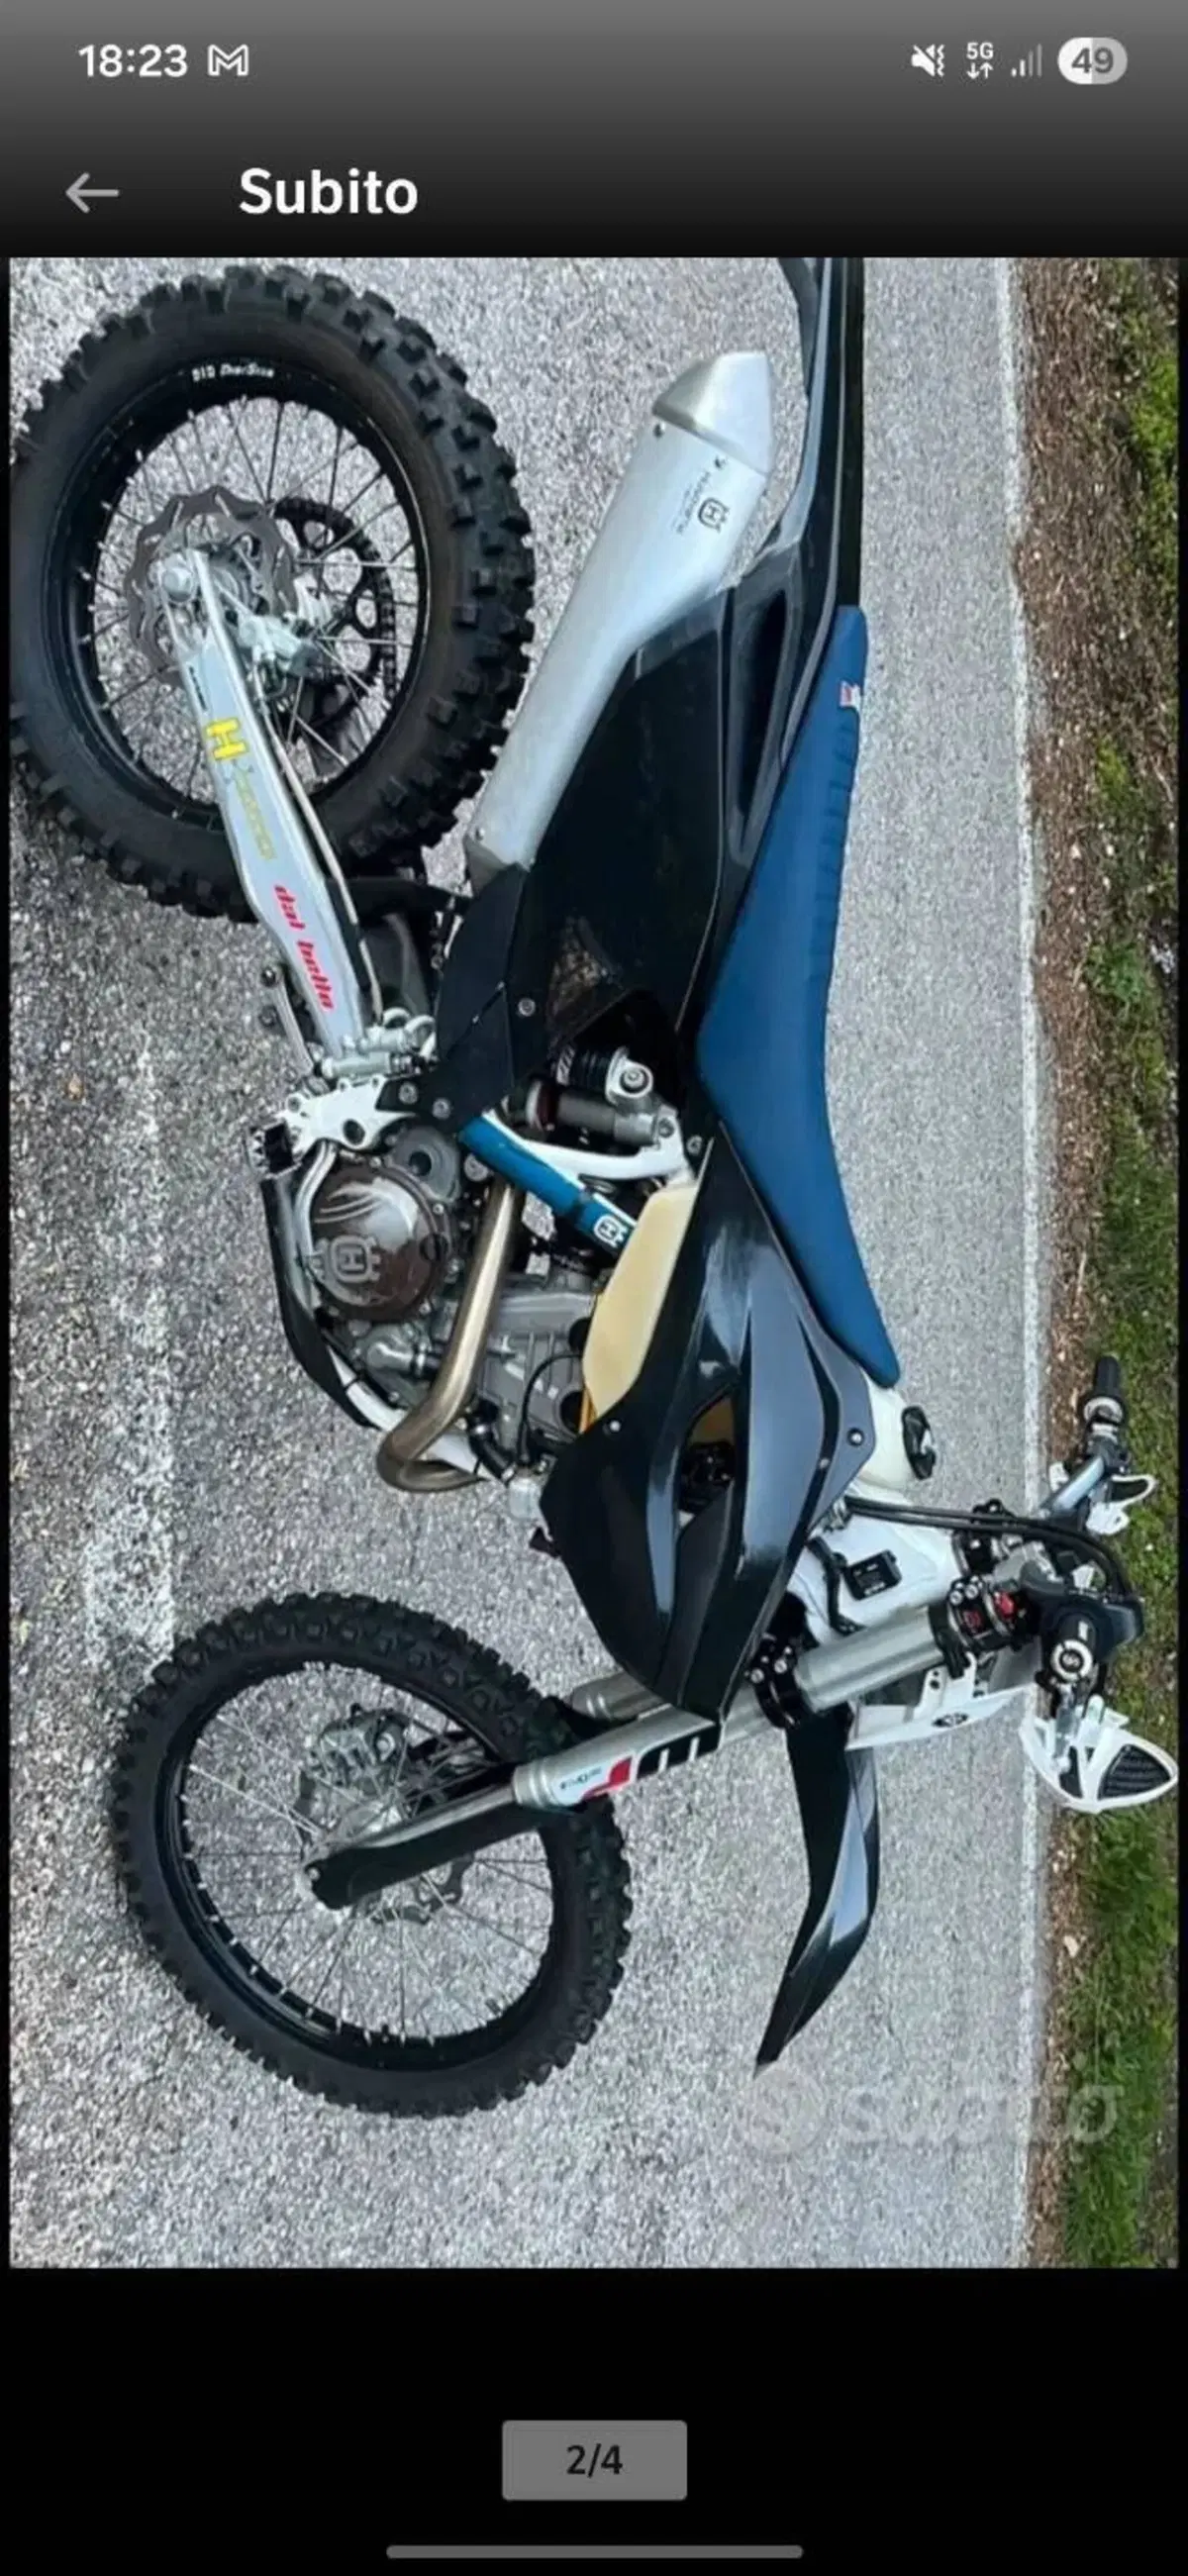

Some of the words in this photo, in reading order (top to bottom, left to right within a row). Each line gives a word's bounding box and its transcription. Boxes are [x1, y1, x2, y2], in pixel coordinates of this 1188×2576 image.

[78, 44, 188, 77] 18:23
[966, 42, 994, 59] 5G
[1070, 47, 1115, 74] 49
[239, 166, 420, 215] Subito
[204, 718, 248, 761] H
[274, 885, 305, 931] dal
[297, 940, 334, 1010] bello
[566, 2442, 624, 2478] 2/4
